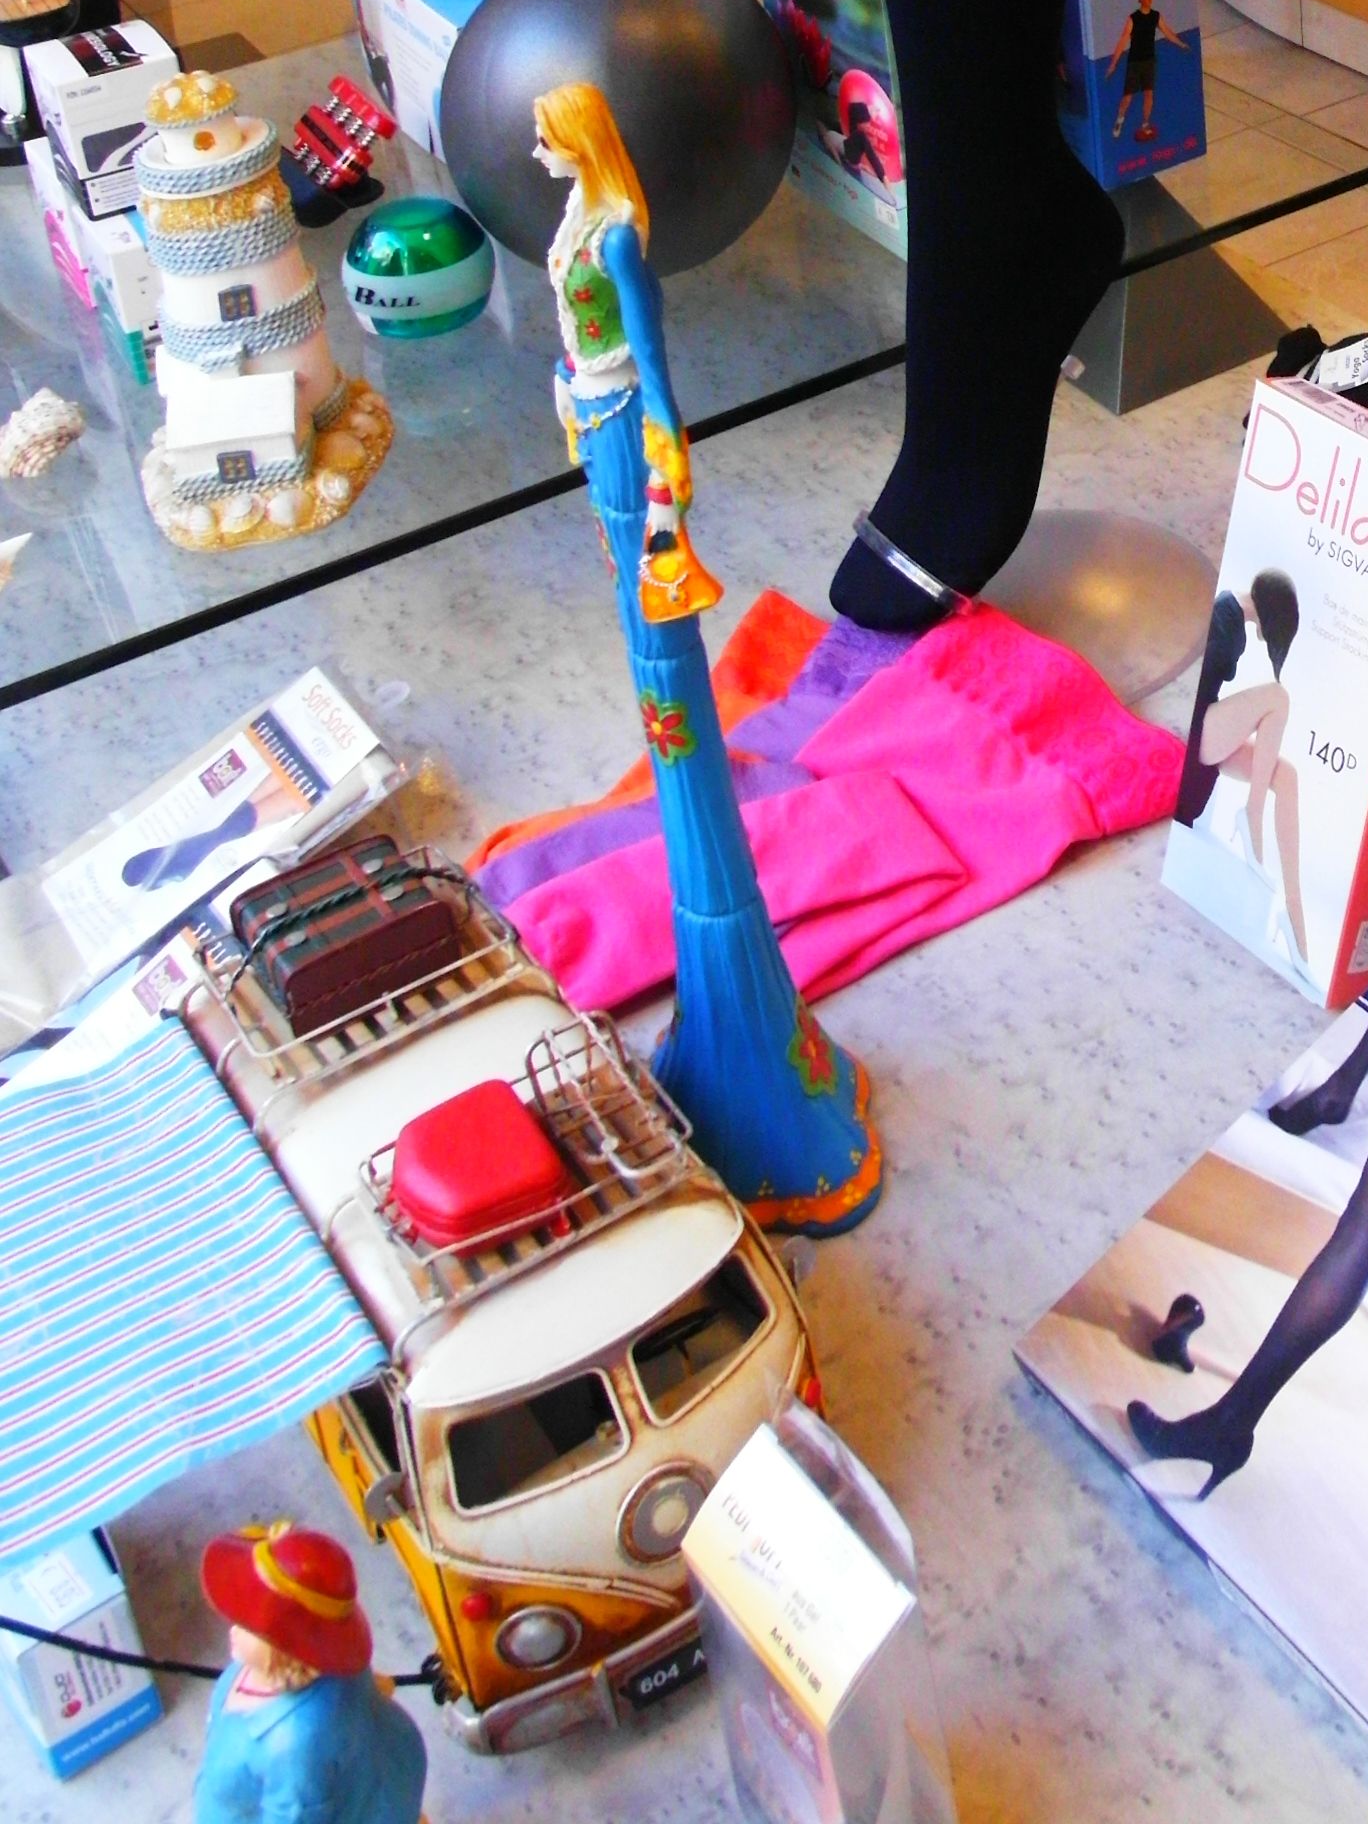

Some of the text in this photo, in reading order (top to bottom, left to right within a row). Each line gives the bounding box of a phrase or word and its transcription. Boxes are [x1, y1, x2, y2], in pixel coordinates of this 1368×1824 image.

[1307, 528, 1324, 555] by
[302, 683, 357, 750] Soft Socks
